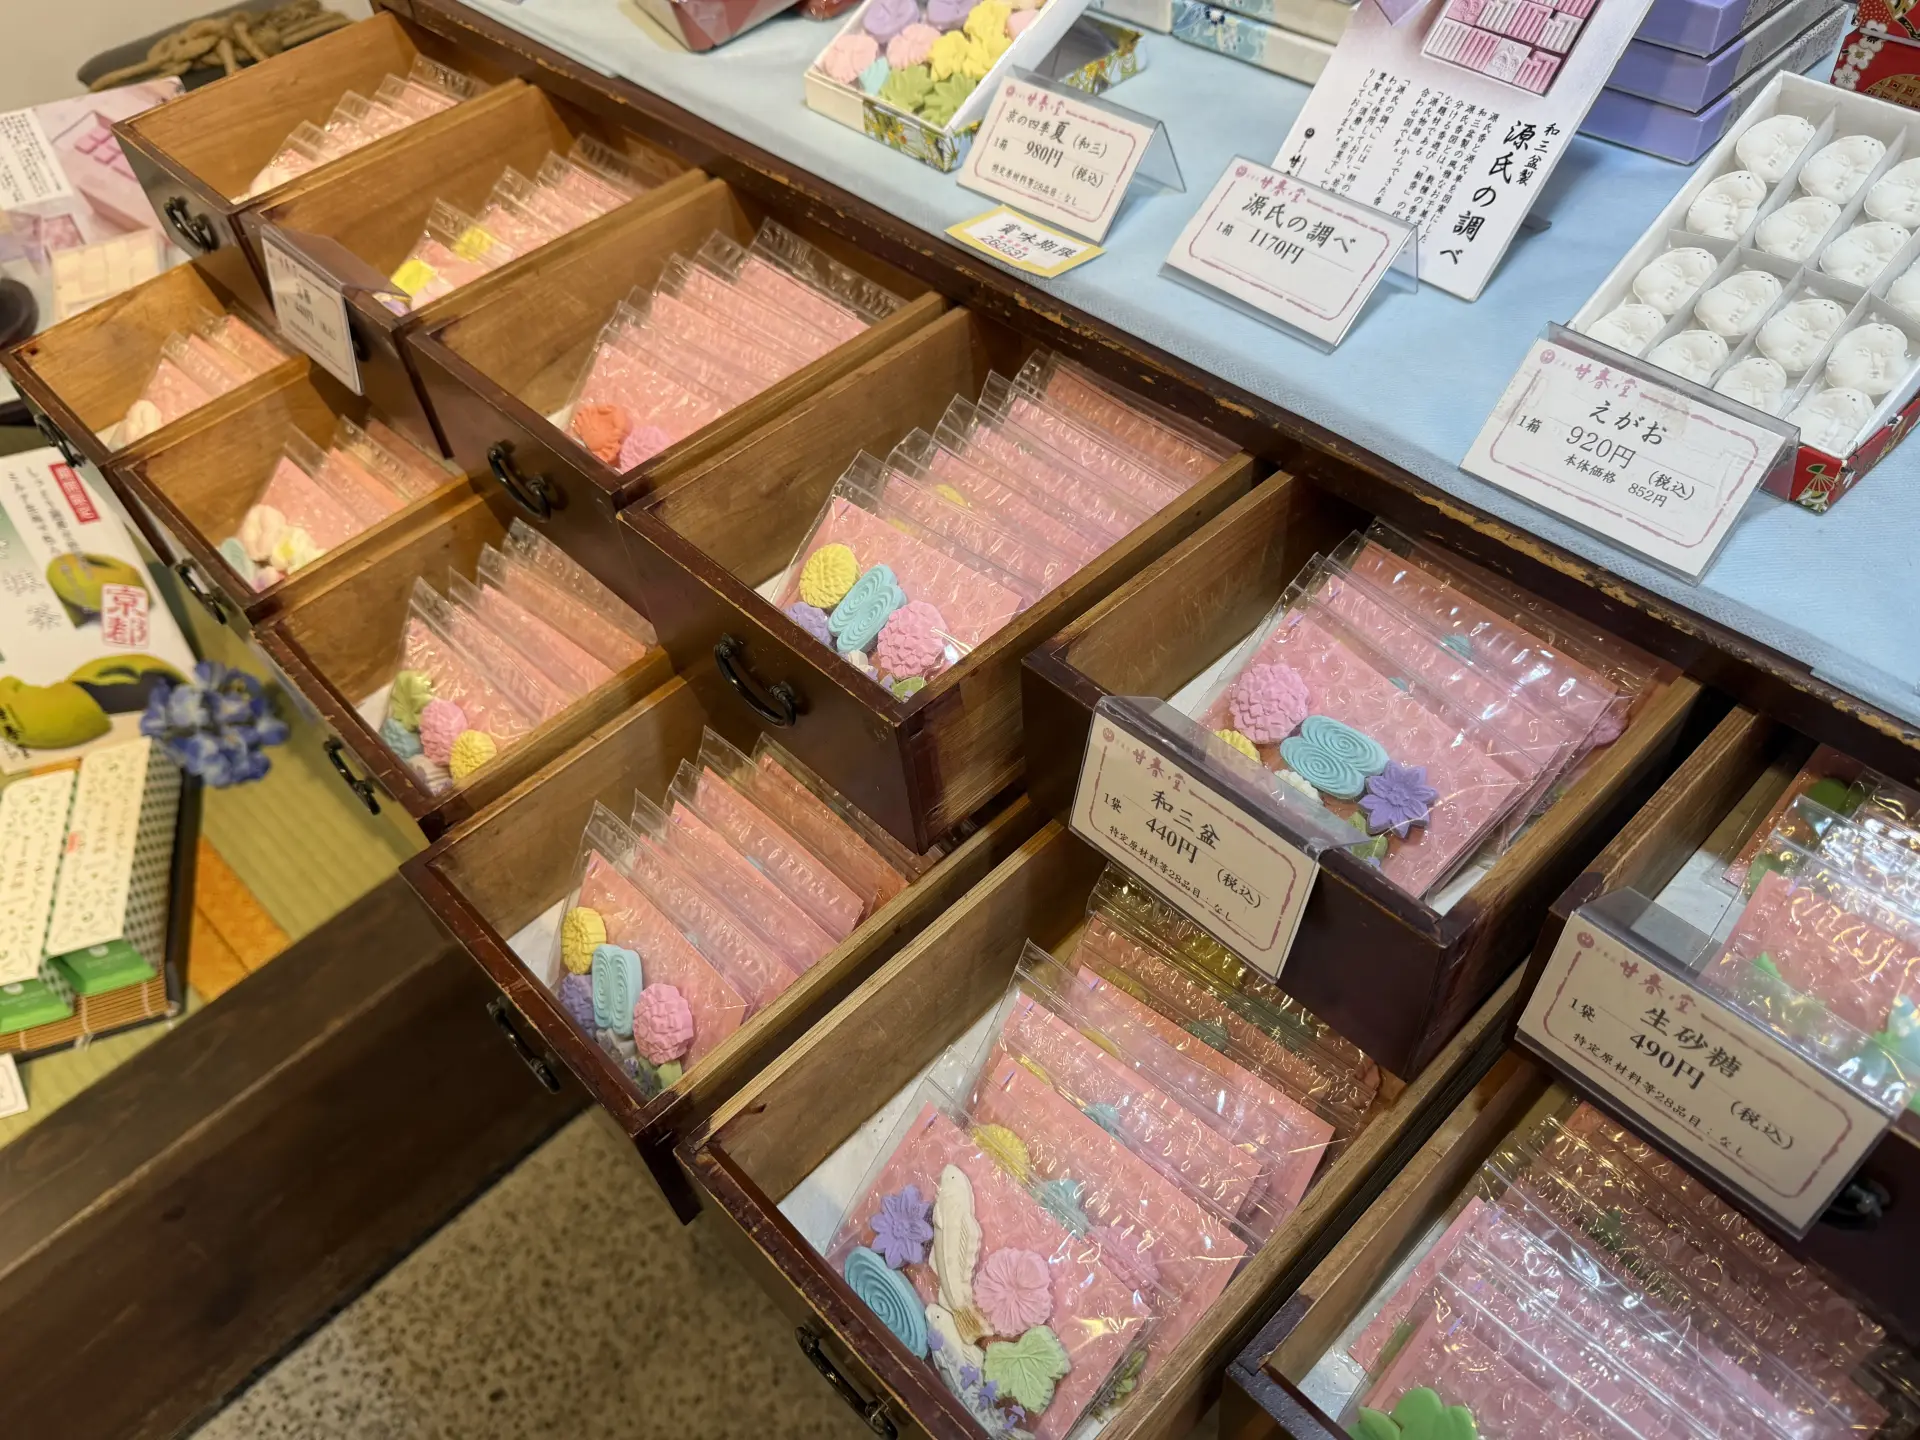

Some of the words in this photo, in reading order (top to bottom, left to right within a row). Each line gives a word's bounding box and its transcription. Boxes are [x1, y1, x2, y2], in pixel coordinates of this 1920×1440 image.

[1006, 108, 1070, 144] 京の四季夏
[1073, 134, 1107, 158] （和三）
[1516, 123, 1560, 187] 和三盆製
[1024, 141, 1064, 168] 980円
[1072, 165, 1103, 188] （税込）
[1440, 120, 1536, 265] 源氏の調べ
[998, 223, 1077, 258] 賞味期限
[1216, 221, 1234, 237] 1箱
[1249, 228, 1304, 264] 1170円
[1242, 192, 1356, 253] 源氏の調べ
[1574, 363, 1637, 398] 甘春堂
[1589, 400, 1667, 445] えがお
[1517, 415, 1543, 434] 1箱
[1566, 425, 1636, 470] 920円
[1648, 470, 1695, 501] （税込）
[1564, 453, 1616, 484] 本体価格
[1628, 482, 1667, 508] 852円
[1133, 748, 1186, 792] 甘春堂
[1151, 790, 1220, 850] 和三盆
[1103, 792, 1122, 814] 1袋
[1145, 818, 1199, 864] 440円
[1217, 868, 1261, 909] （税込）
[1620, 960, 1697, 1015] 甘春堂
[1640, 1007, 1742, 1078] 生砂糖
[1569, 997, 1596, 1023] 1袋
[1629, 1033, 1705, 1090] 490円
[1730, 1100, 1794, 1150] （税込）
